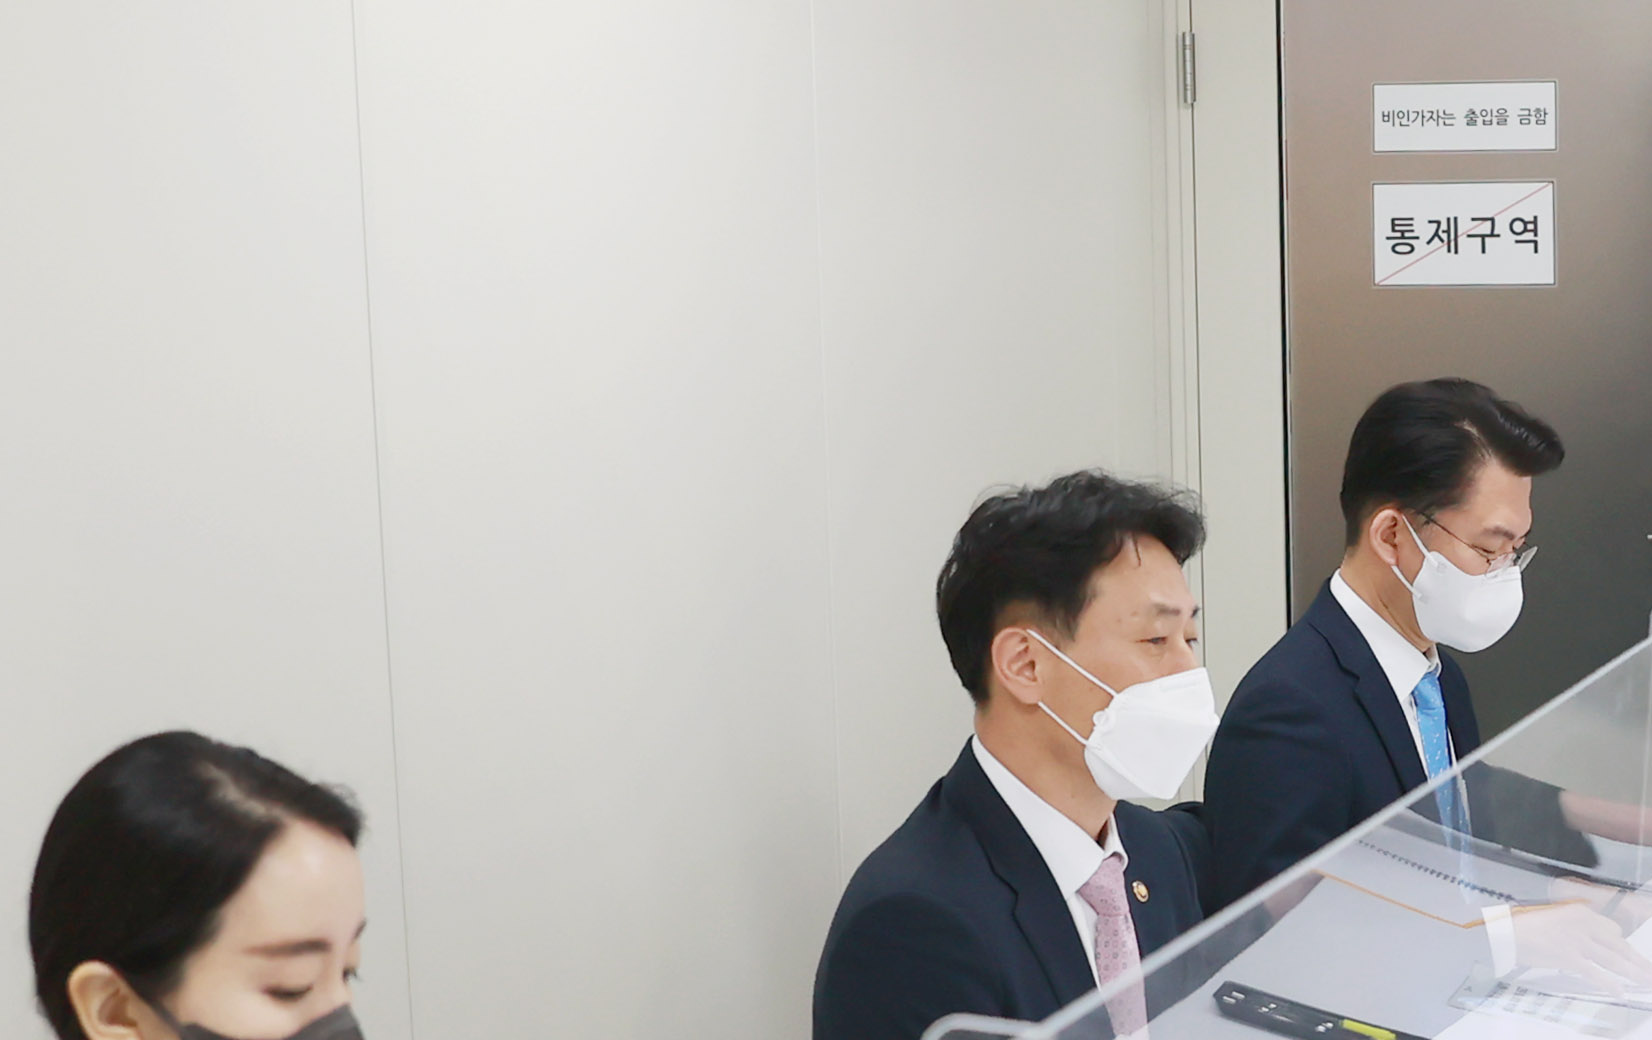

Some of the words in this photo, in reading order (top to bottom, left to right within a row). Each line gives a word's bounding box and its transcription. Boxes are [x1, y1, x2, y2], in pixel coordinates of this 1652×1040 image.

[1381, 108, 1457, 128] 비인가자는
[1463, 107, 1510, 127] 출입을
[1517, 107, 1549, 126] 금함
[1385, 215, 1539, 255] 통제구역
